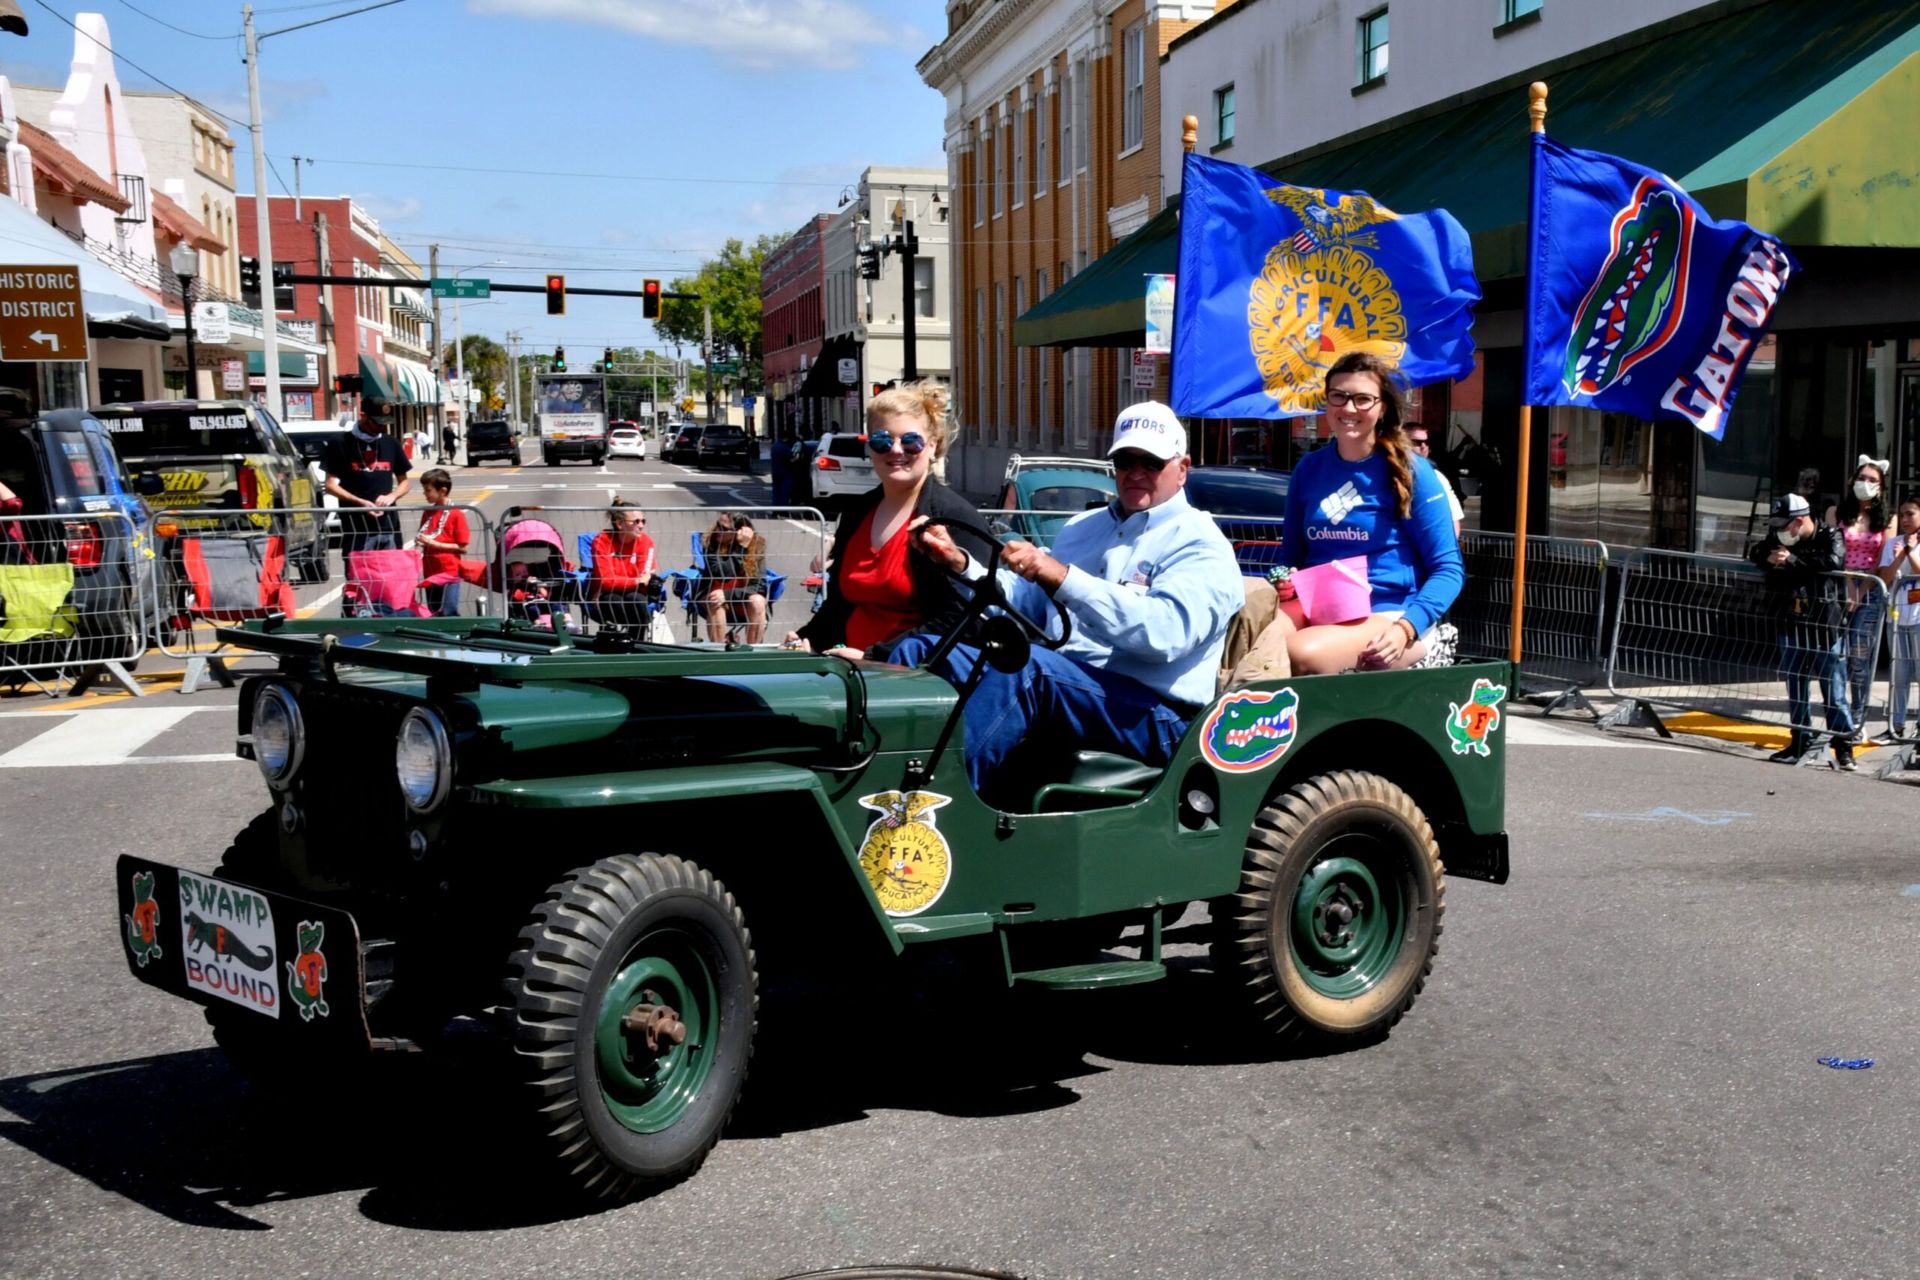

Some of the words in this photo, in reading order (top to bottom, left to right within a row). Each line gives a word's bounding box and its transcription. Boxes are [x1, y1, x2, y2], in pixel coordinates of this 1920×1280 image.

[0, 273, 75, 289] HISTORIC
[1, 302, 75, 317] DISTRICT
[1272, 269, 1379, 337] AGRICULTURAL
[1296, 292, 1355, 329] FFA
[1120, 418, 1166, 434] GATORS
[1307, 526, 1370, 541] Columbia
[873, 834, 935, 867] AGRICULTURAL
[889, 846, 923, 862] FFA
[877, 881, 929, 900] EDUCATION
[178, 875, 268, 928] SWAMP
[186, 957, 276, 1008] BOUND
